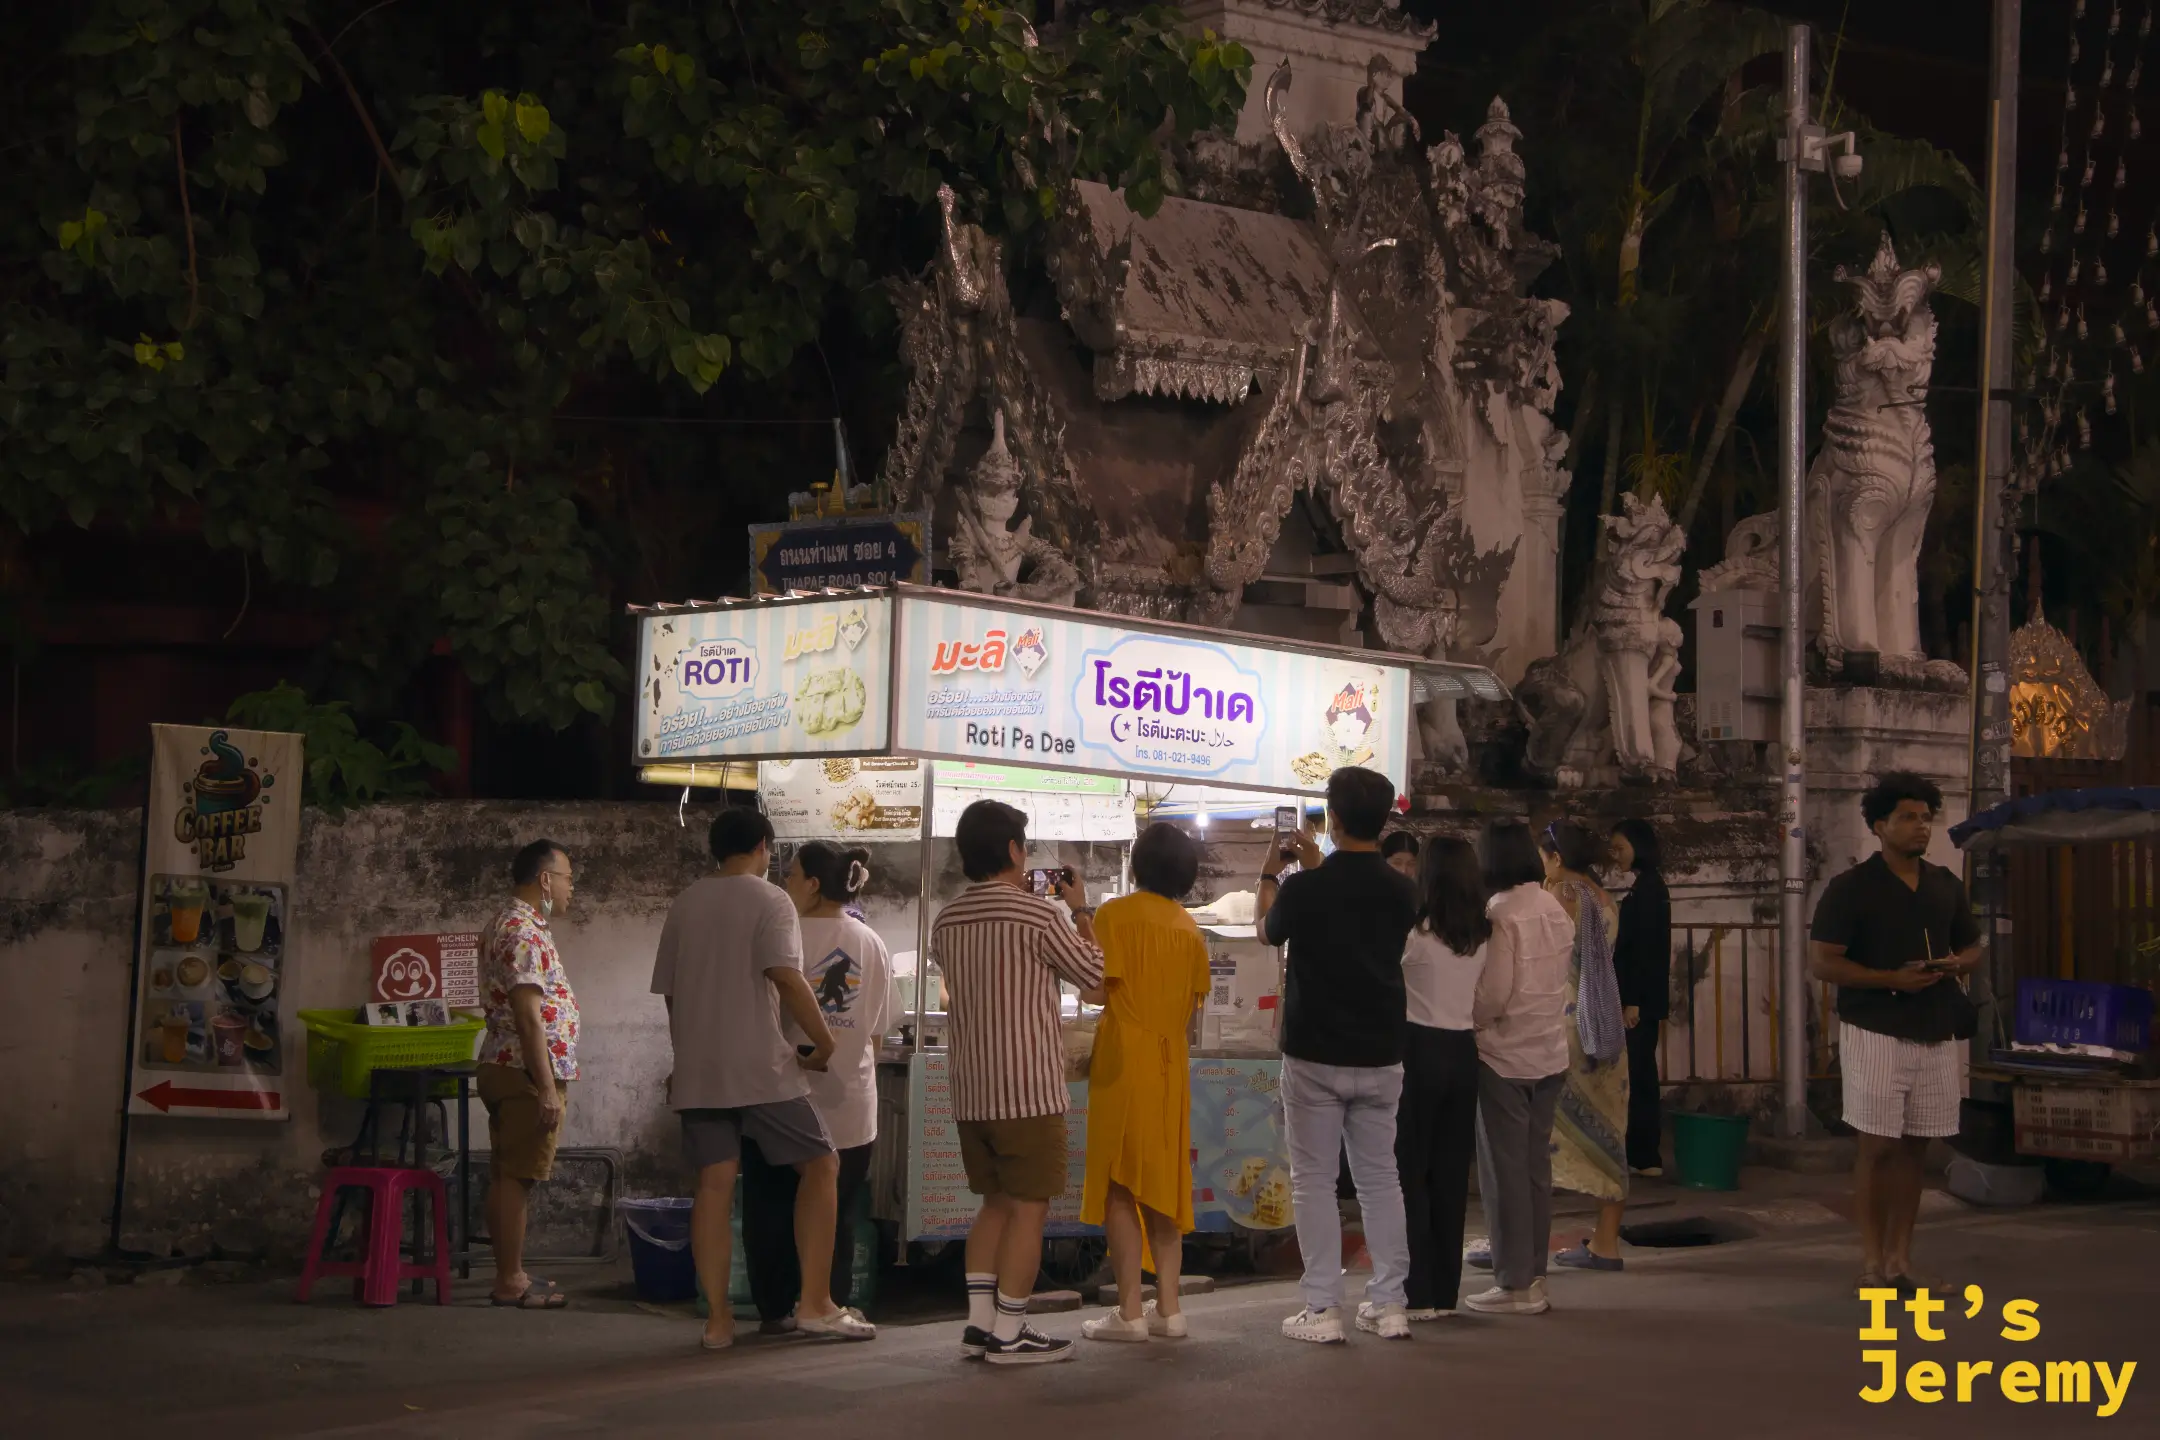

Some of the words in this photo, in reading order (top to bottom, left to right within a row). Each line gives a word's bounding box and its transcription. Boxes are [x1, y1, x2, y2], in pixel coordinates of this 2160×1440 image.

[780, 539, 848, 567] ถนนท่าแพ
[853, 540, 882, 561] ซอย
[887, 540, 896, 558] 4
[782, 574, 825, 591] THAPAE
[828, 573, 861, 588] ROAD
[867, 571, 887, 585] SOI
[889, 570, 897, 583] 4
[700, 645, 736, 657] โรตีป้าเด
[932, 630, 1006, 671] มะลิ
[1017, 631, 1040, 648] Mali
[685, 657, 750, 686] ROTI
[1094, 659, 1254, 723] โรตีป้าเด
[1331, 687, 1365, 713] Mali
[966, 723, 1006, 748] Roti
[1012, 728, 1034, 750] Pa
[1041, 732, 1075, 753] Dae
[1137, 716, 1206, 743] โรตีมะตะบะ
[1208, 728, 1235, 748] حلال
[1153, 749, 1211, 766] 081-021-9496
[175, 805, 262, 843] COFFEE
[200, 834, 246, 869] BAR
[436, 933, 479, 944] MICHELIN
